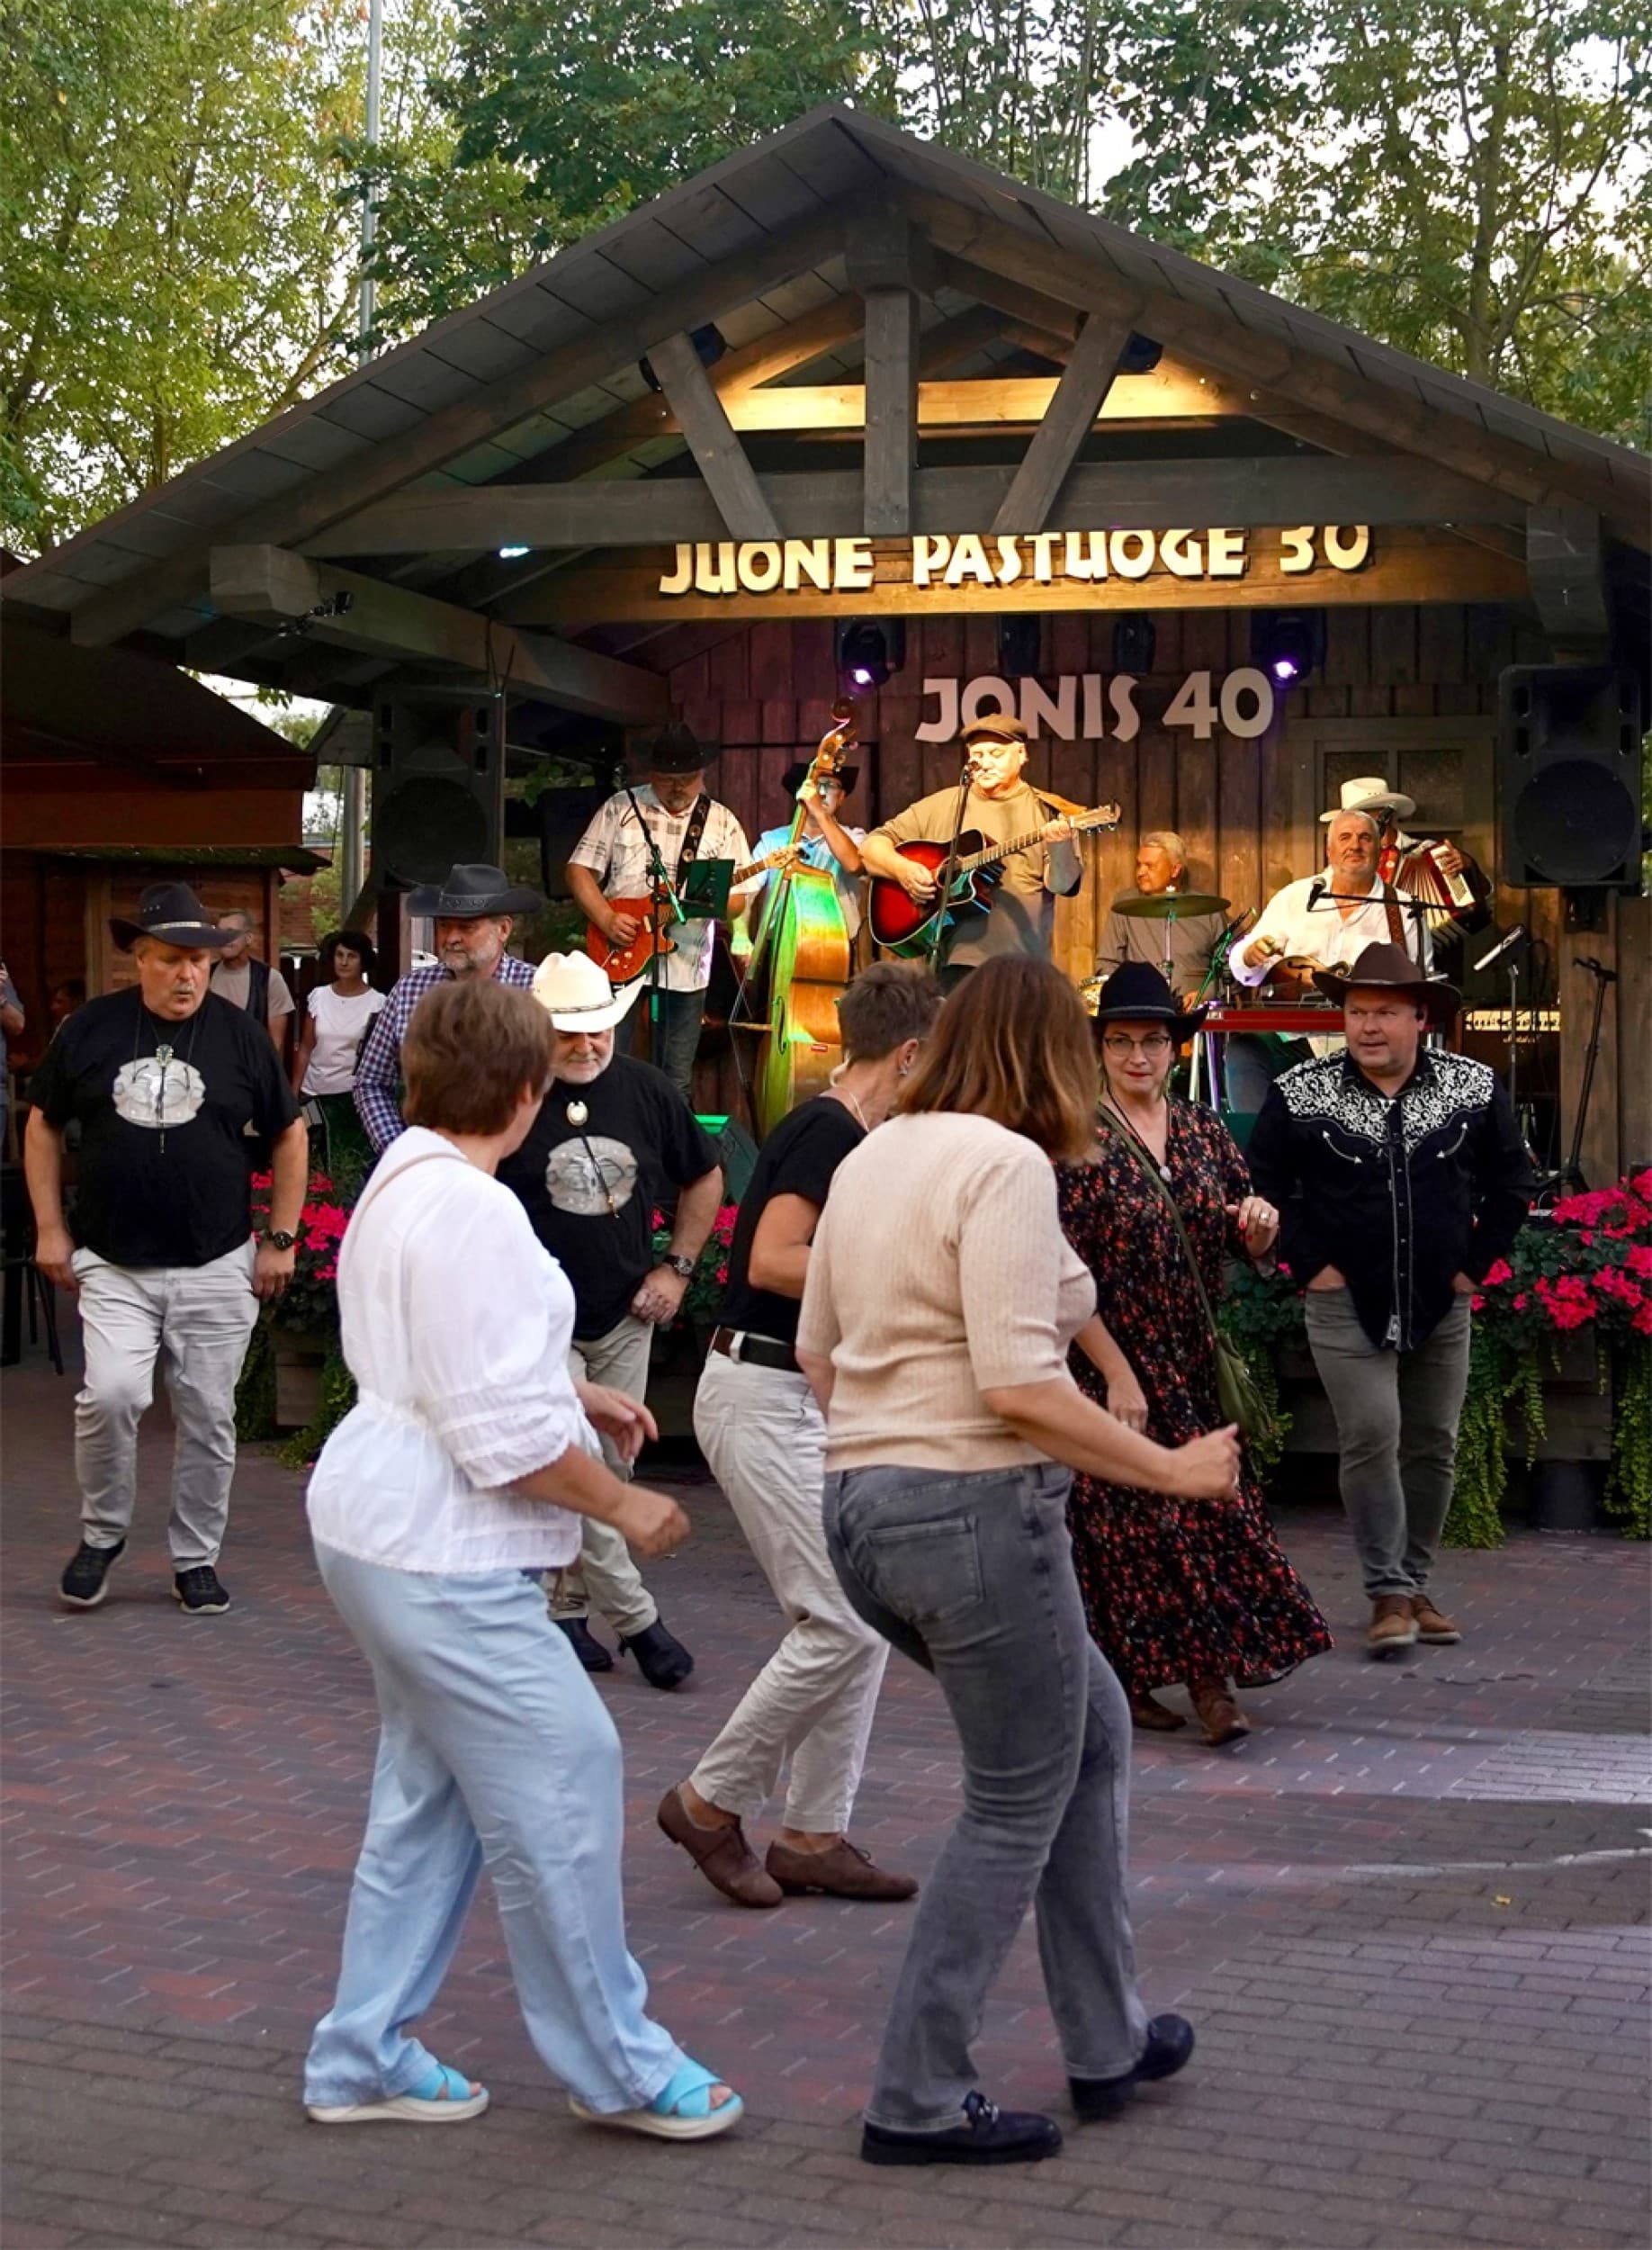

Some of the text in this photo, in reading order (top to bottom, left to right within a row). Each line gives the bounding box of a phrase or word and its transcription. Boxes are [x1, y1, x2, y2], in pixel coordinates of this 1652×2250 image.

[659, 537, 874, 594] JUONE
[1279, 525, 1369, 572] 30
[914, 667, 1274, 743] JONIS 40
